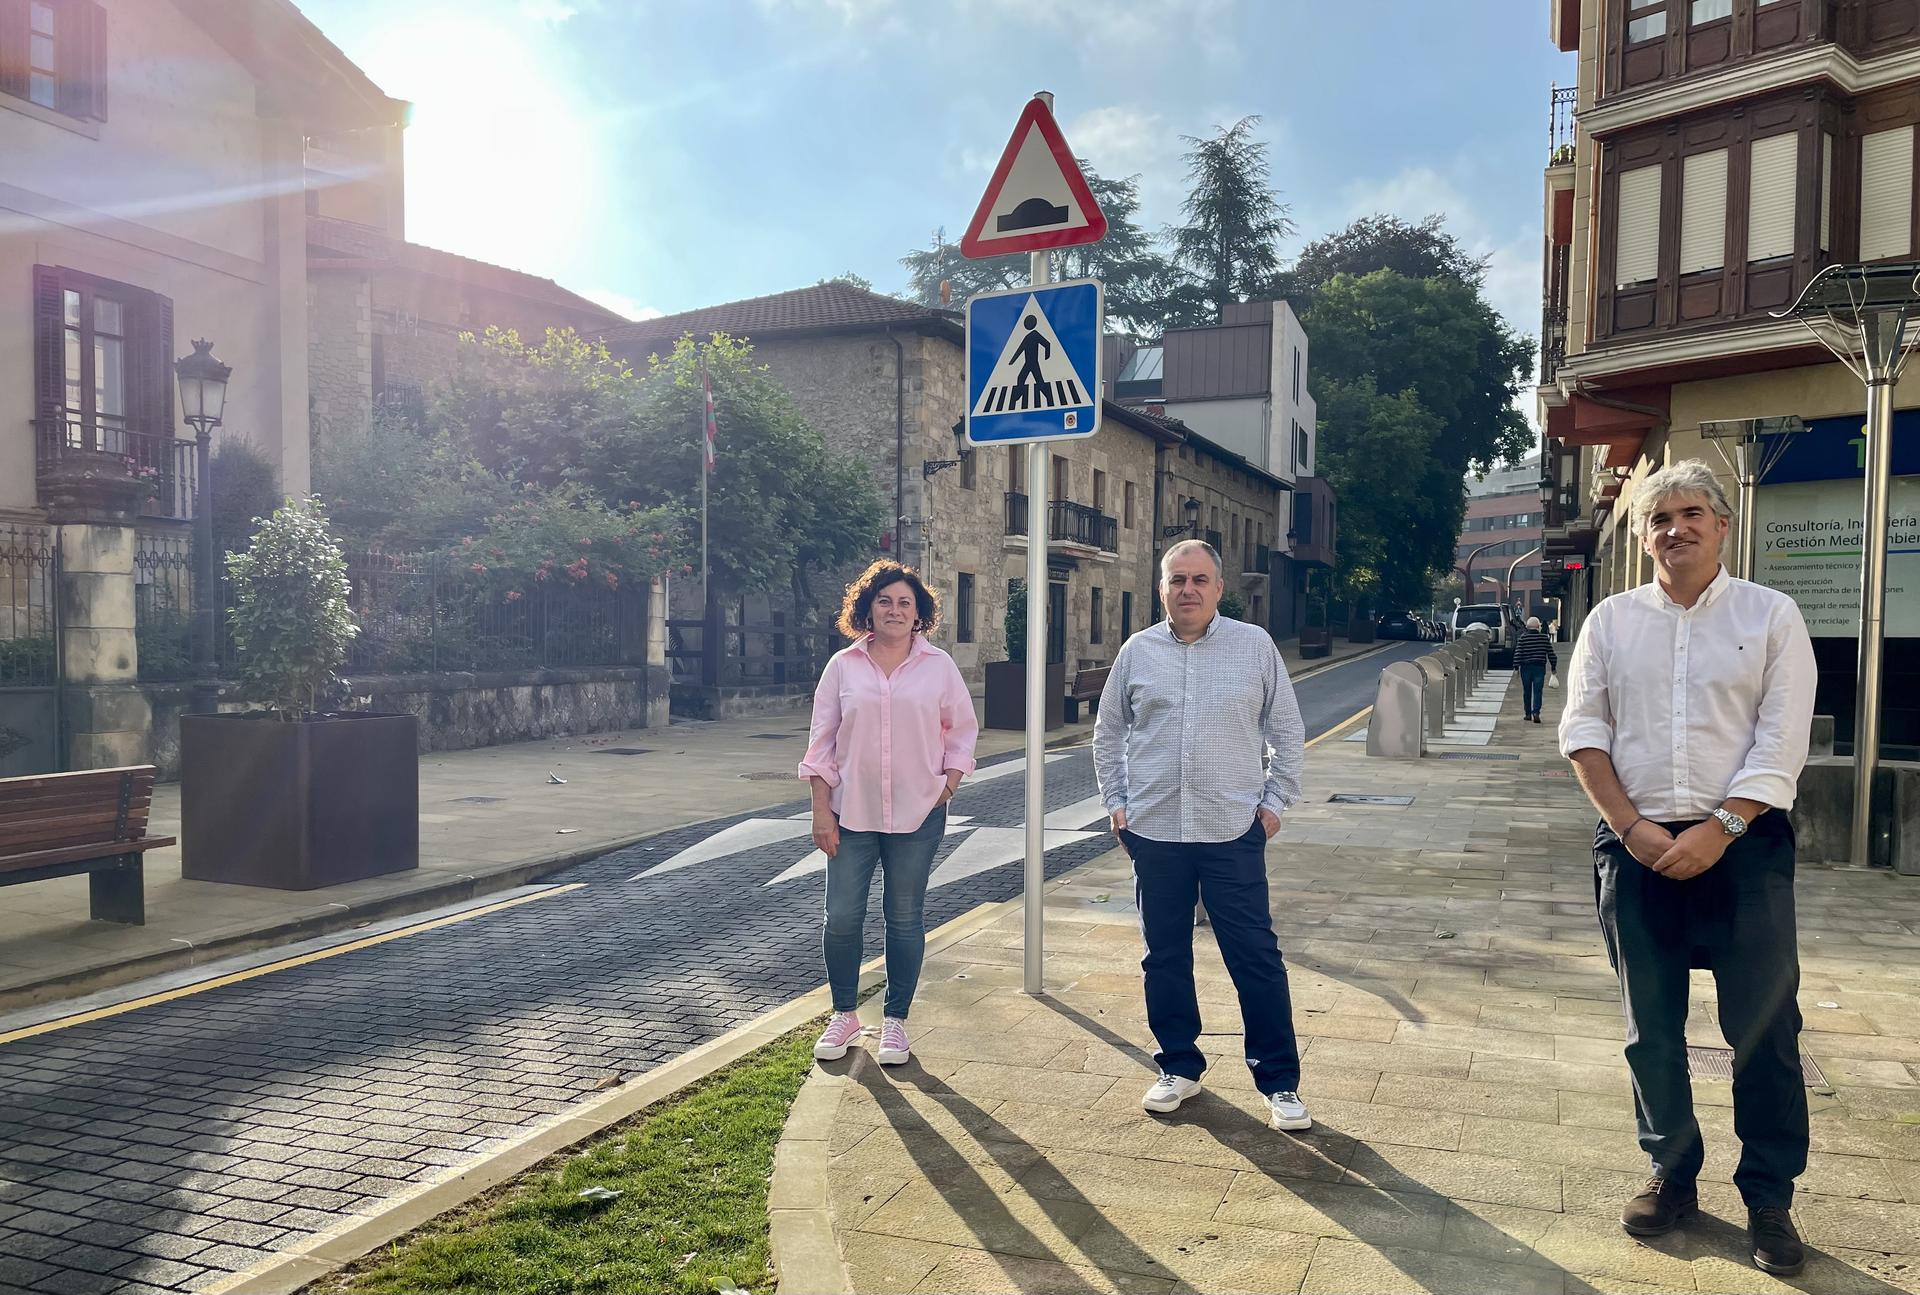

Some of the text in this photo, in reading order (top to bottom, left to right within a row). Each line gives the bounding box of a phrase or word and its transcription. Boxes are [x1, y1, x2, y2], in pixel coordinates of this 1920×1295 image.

[1766, 519, 1844, 533] Consultoría,
[1765, 540, 1773, 551] y
[1776, 536, 1826, 549] Gestión
[1797, 578, 1833, 587] ejecución
[1841, 586, 1852, 594] de
[1819, 617, 1850, 626] reciclaje
